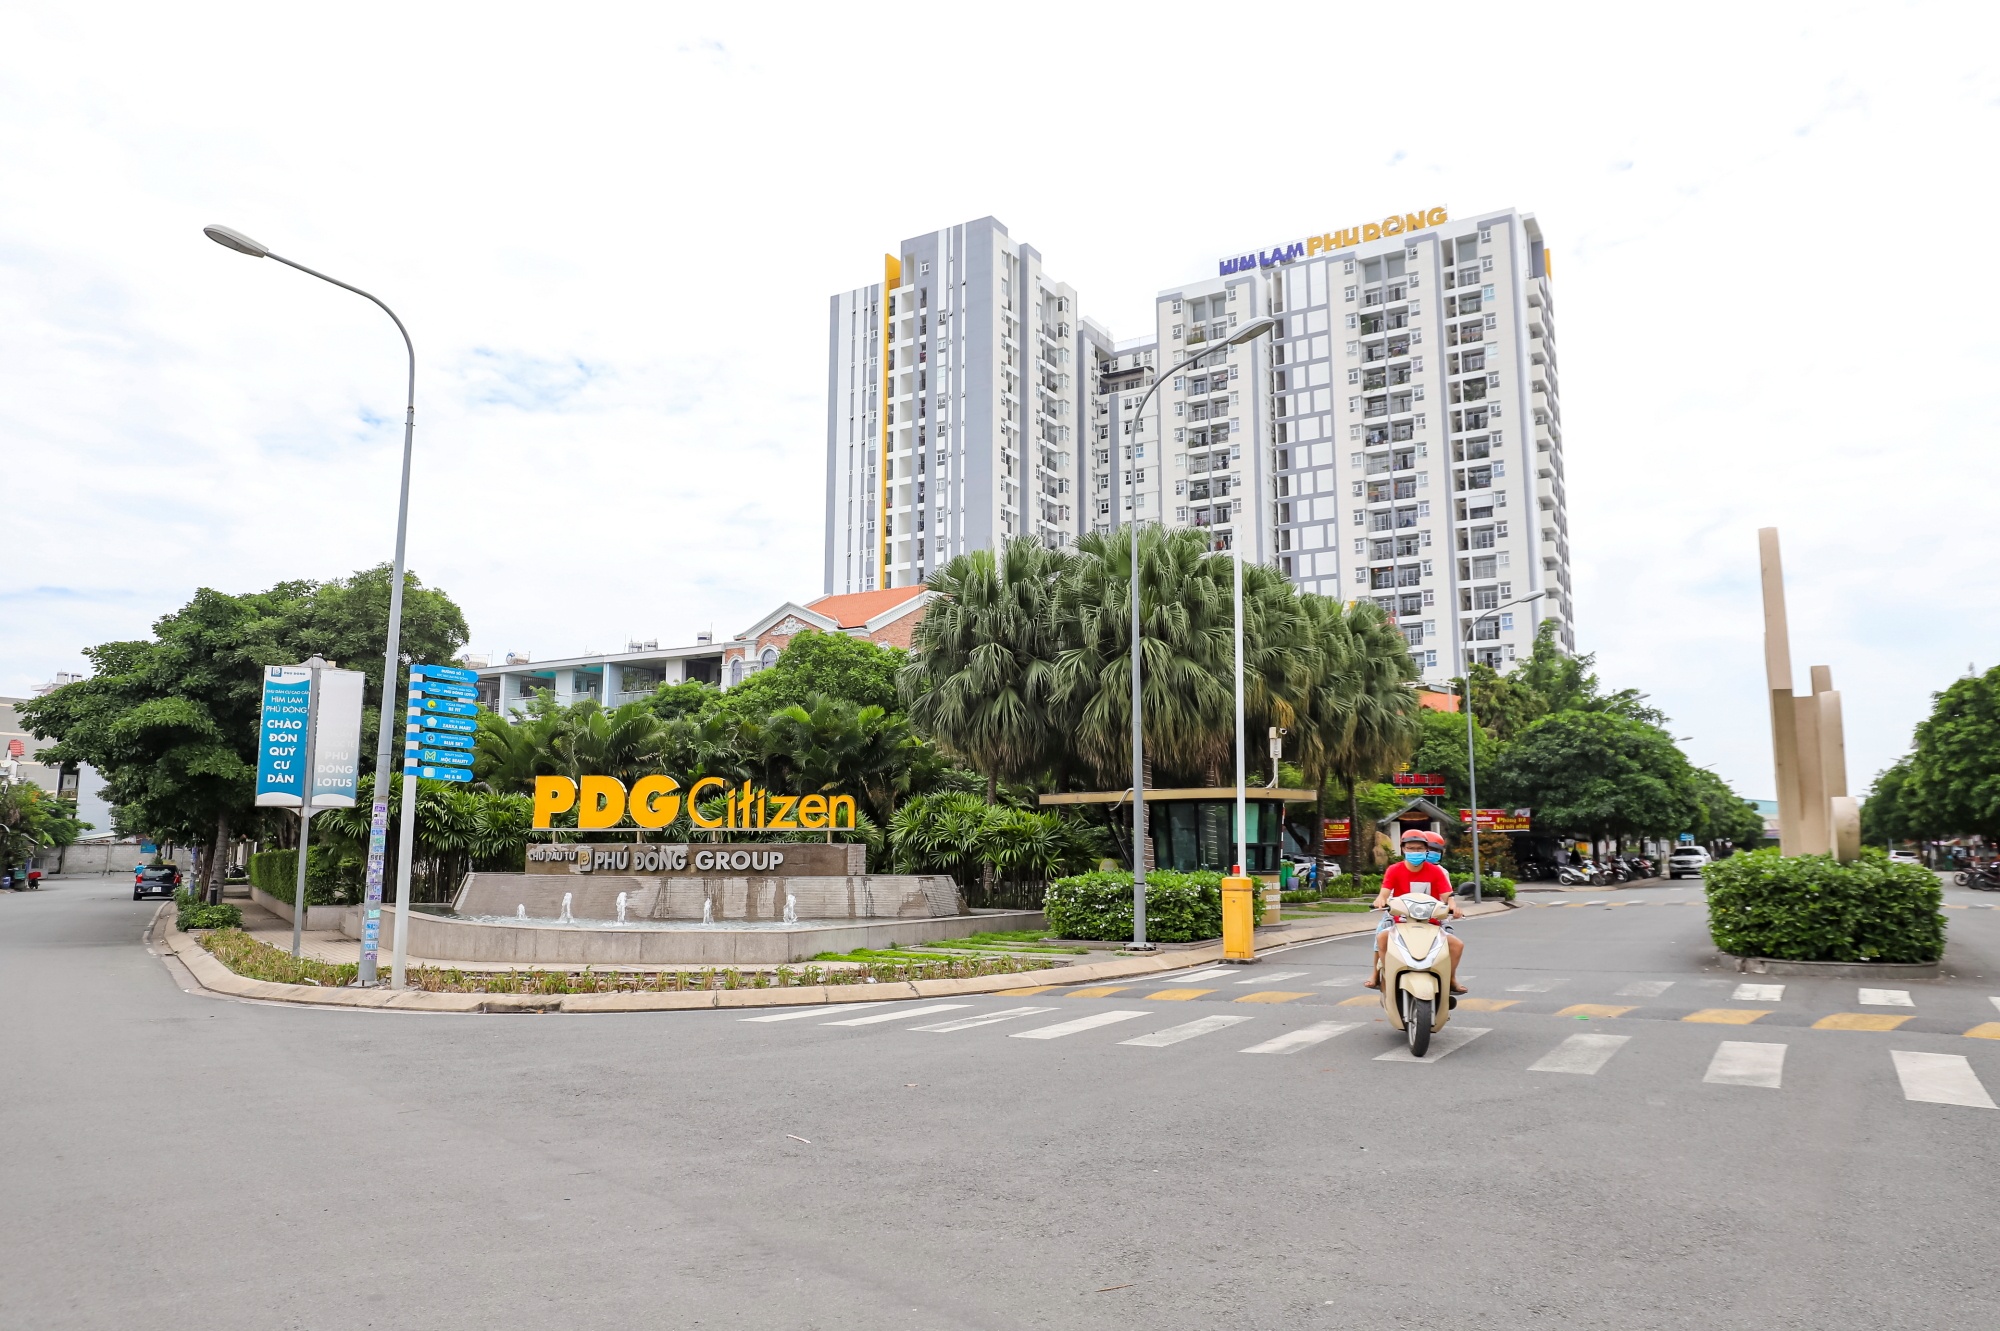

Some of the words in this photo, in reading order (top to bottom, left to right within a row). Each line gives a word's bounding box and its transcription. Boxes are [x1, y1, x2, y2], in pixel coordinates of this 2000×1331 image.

[1219, 253, 1256, 276] HIM
[1259, 242, 1304, 270] LAM
[287, 696, 303, 704] LAM
[266, 705, 281, 713] PHÚ
[282, 705, 307, 714] ĐÔNG
[267, 717, 302, 729] CHÀO
[268, 731, 298, 743] ĐÓN
[269, 744, 296, 757] QUÝ
[324, 749, 349, 761] PHÚ
[273, 760, 291, 770] CƯ
[317, 762, 354, 774] ĐÔNG
[267, 772, 294, 784] DÂN
[317, 777, 353, 788] LOTUS
[532, 774, 681, 830] PDG
[687, 776, 857, 829] Citizen
[594, 845, 630, 870] PHÚ
[634, 845, 688, 872] ĐÔNG
[695, 851, 785, 871] GROUP
